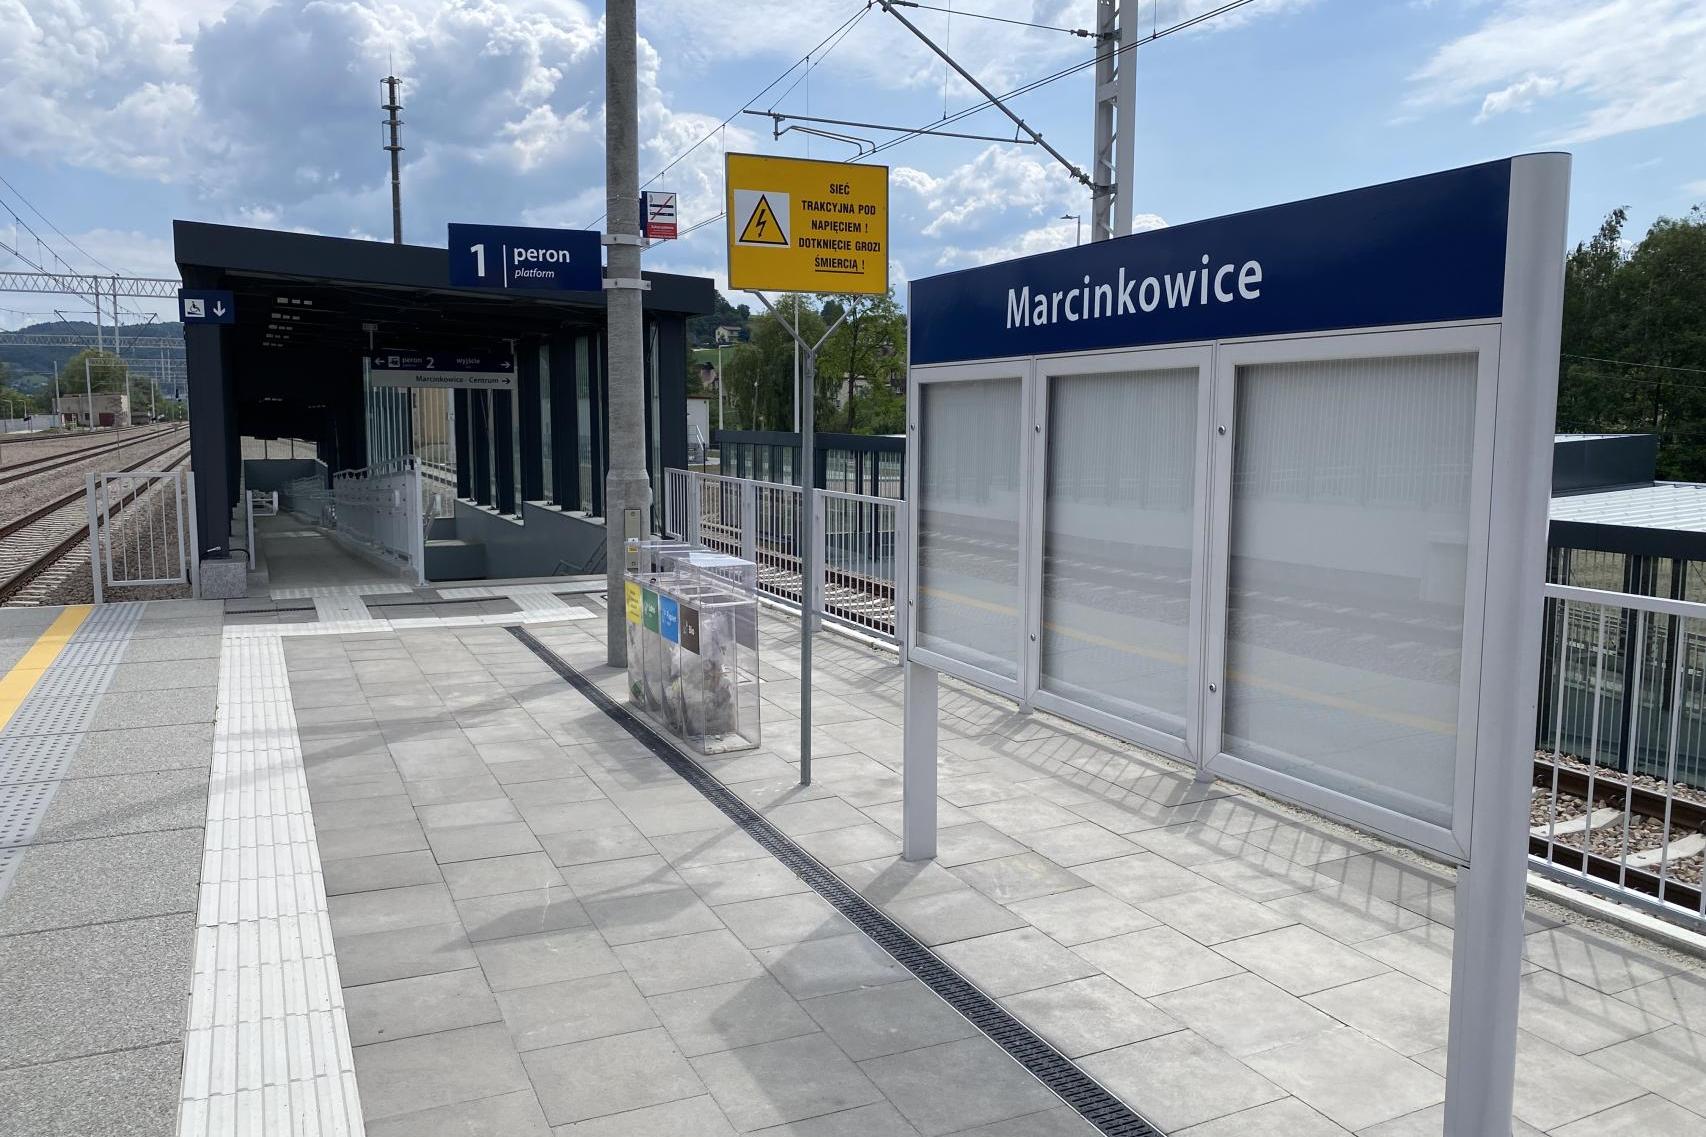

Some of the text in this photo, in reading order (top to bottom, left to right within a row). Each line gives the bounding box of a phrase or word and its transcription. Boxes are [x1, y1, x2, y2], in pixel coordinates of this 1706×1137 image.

[829, 182, 850, 195] SIEĆ
[801, 200, 876, 215] TRAKCYJNA POD
[811, 219, 862, 234] NAPIĘCIEM
[798, 237, 881, 252] DOTKNIĘCIE GROZI
[470, 243, 570, 277] 1 peron
[815, 254, 858, 271] ŚMIERCIĄ
[514, 268, 555, 279] platform
[1006, 253, 1263, 329] Marcinkowice
[426, 356, 435, 369] 2
[468, 376, 499, 385] Centrum
